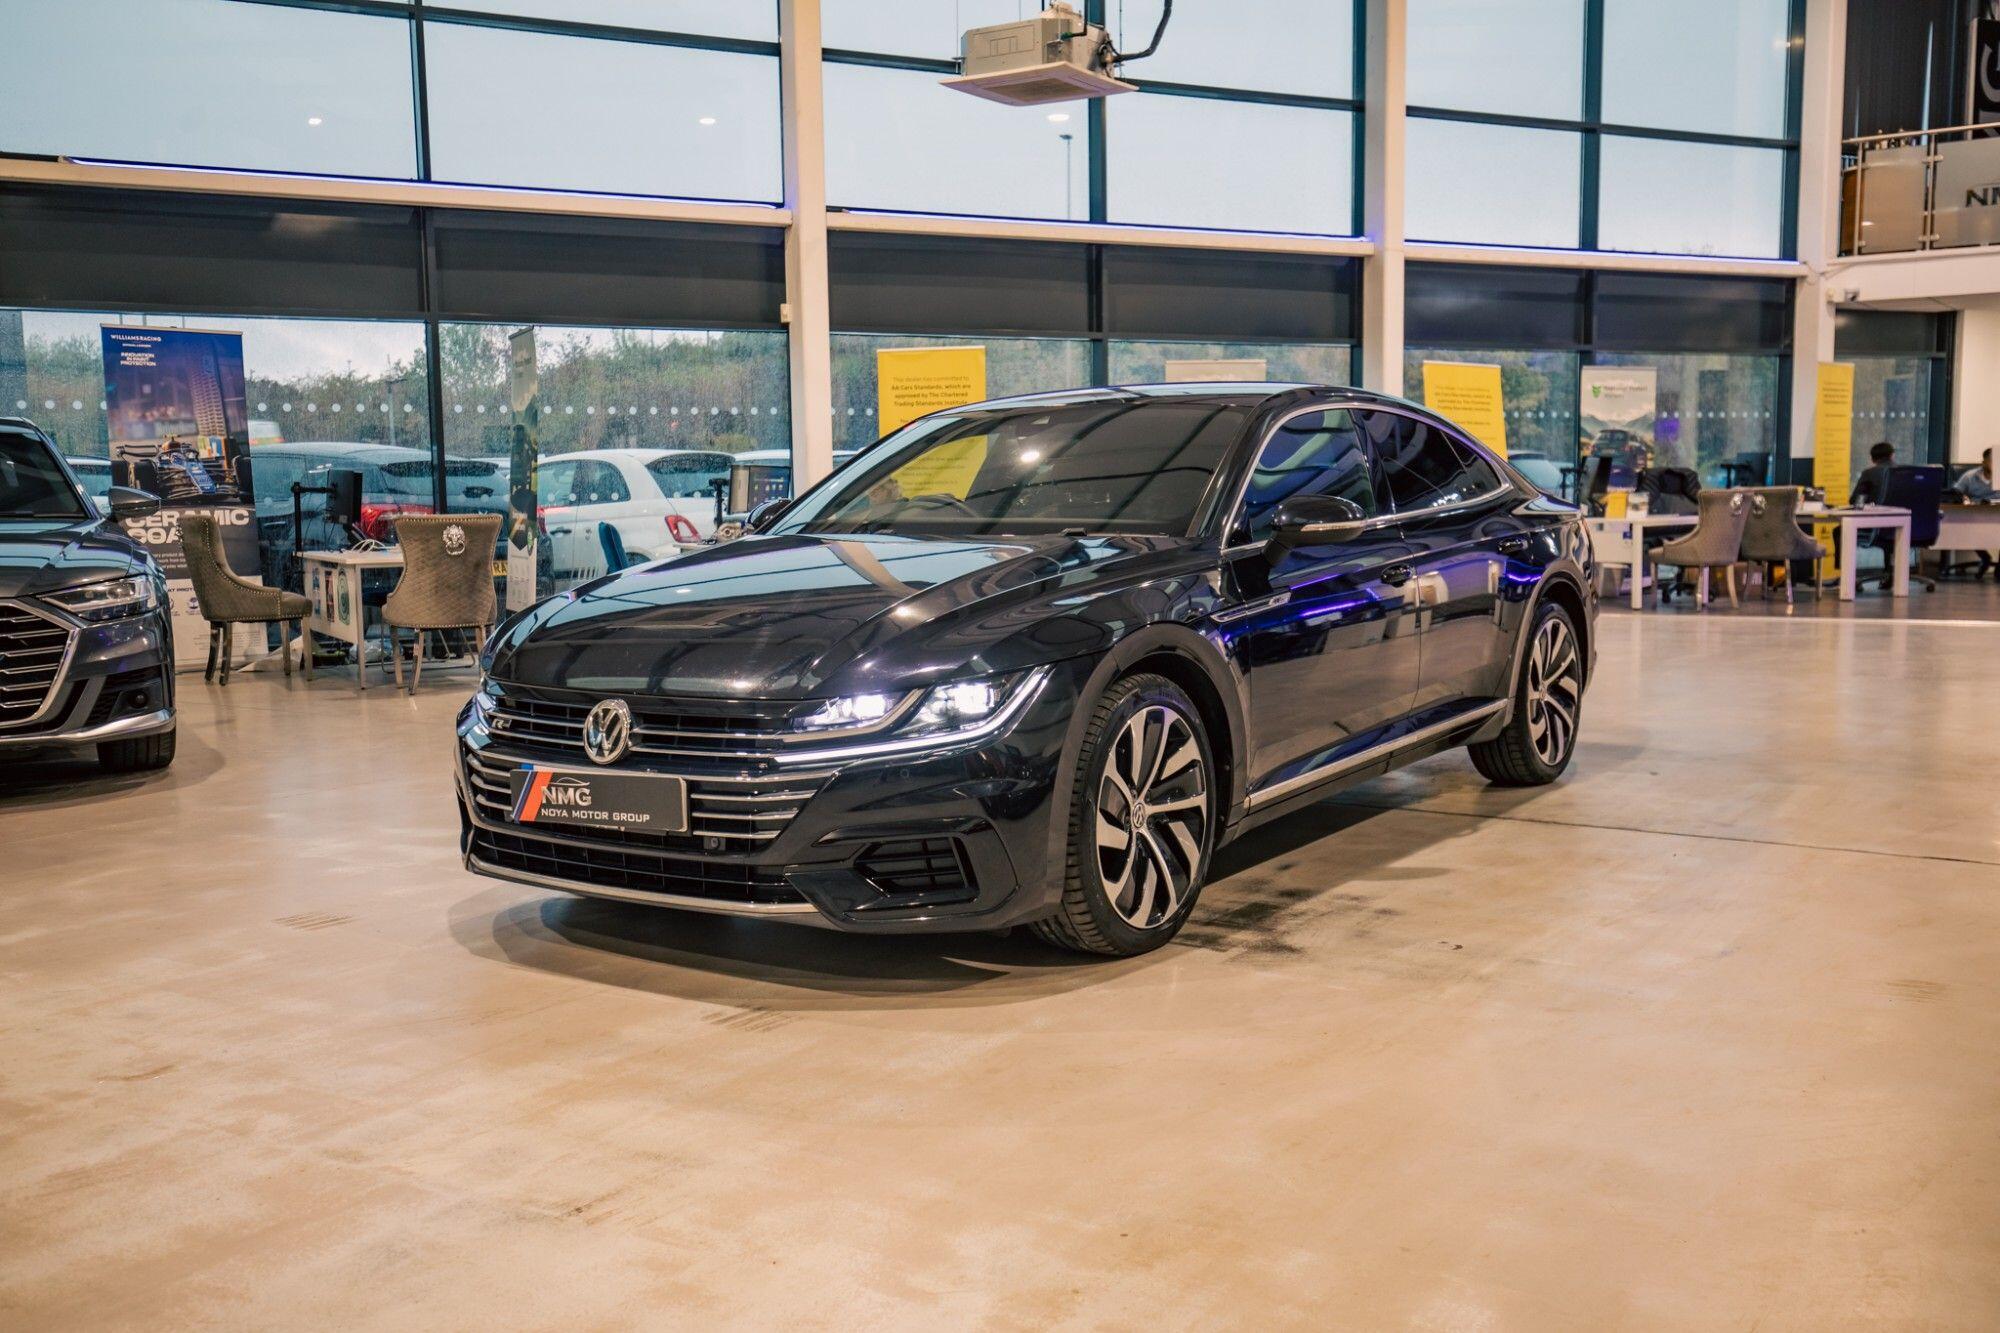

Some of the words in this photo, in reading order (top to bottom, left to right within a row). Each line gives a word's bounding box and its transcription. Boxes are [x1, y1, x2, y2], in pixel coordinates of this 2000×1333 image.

[125, 508, 250, 528] CERMIC
[541, 785, 592, 807] NMG
[541, 808, 568, 818] NOYA
[572, 810, 609, 821] MOTOR
[612, 812, 650, 823] GROUP
